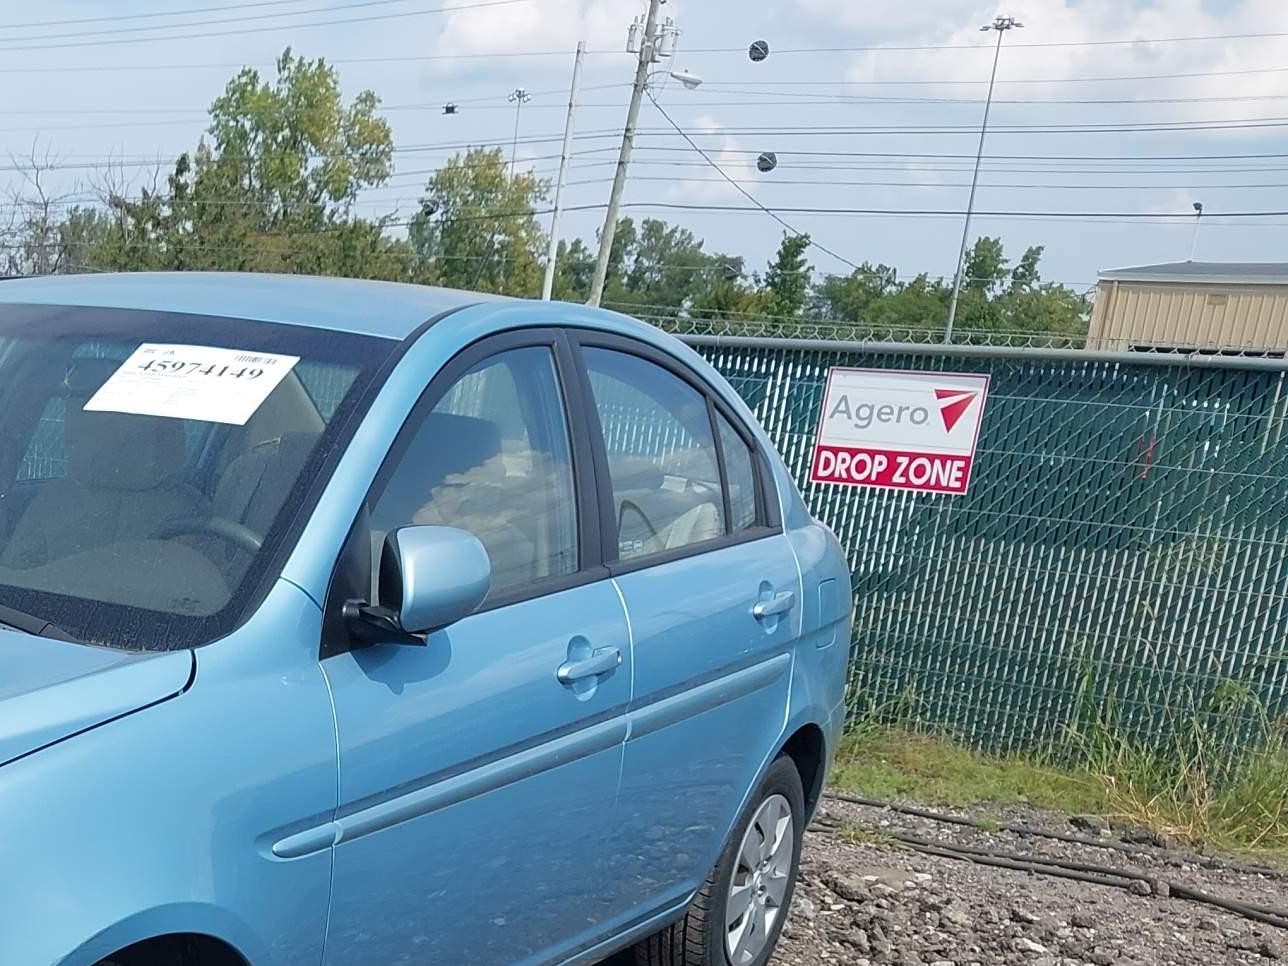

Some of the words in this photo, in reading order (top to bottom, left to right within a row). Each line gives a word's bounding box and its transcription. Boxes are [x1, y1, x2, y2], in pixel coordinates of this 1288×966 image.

[138, 359, 264, 380] 45974149
[829, 394, 929, 429] Agero
[816, 450, 888, 482] DROP
[891, 455, 966, 488] ZONE
